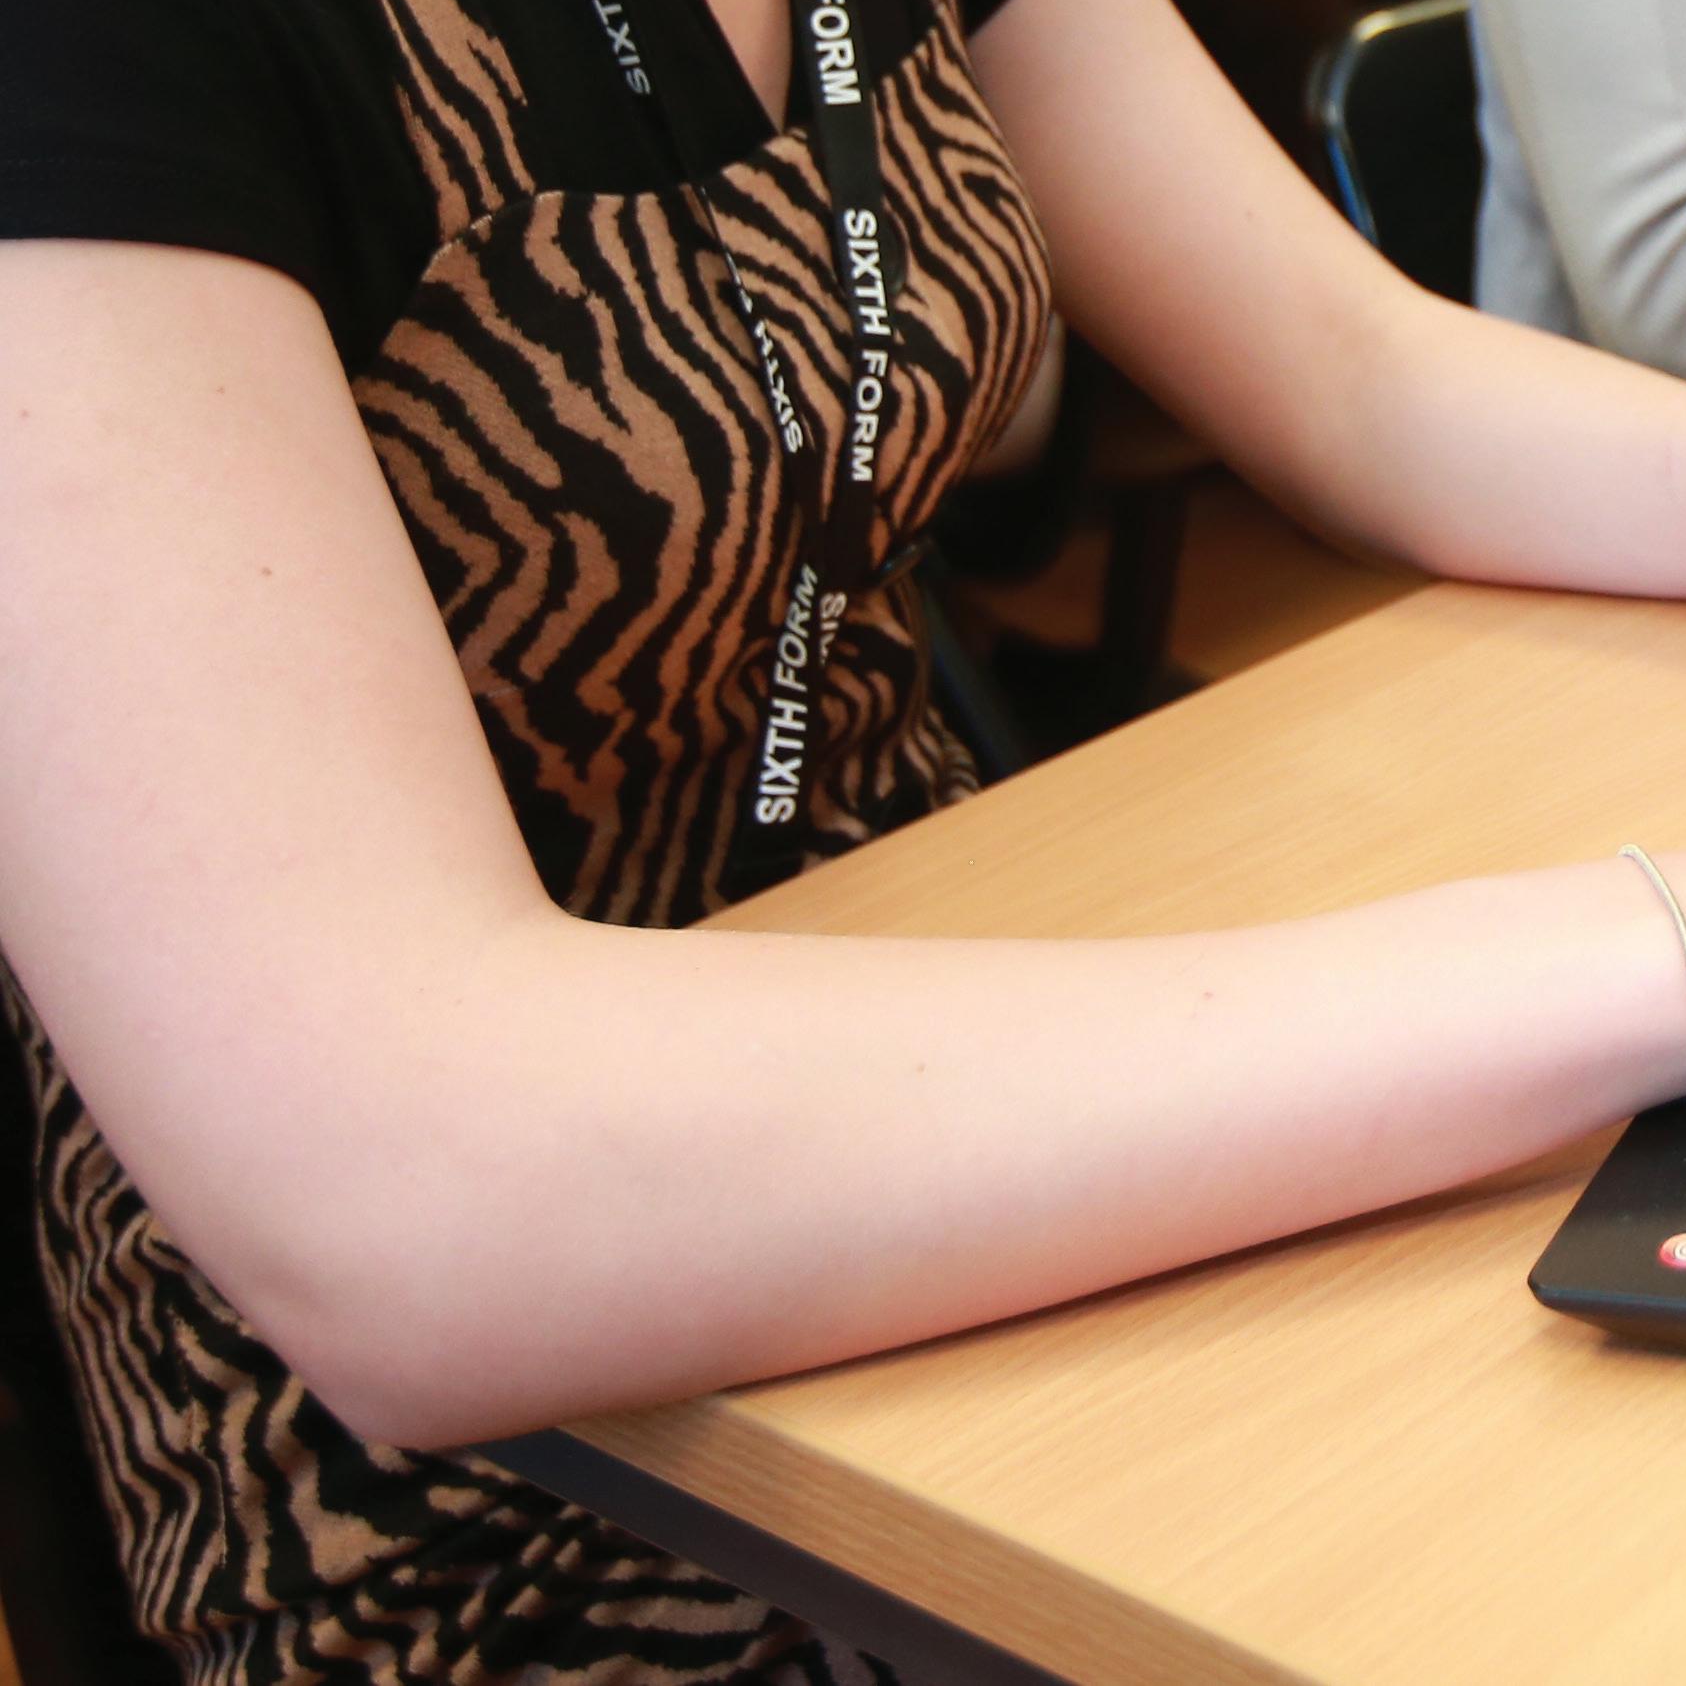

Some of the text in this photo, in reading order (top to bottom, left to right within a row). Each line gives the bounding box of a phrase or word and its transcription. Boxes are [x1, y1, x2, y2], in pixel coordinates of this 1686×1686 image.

[843, 210, 892, 482] SIXTH FORM
[754, 563, 818, 825] SIXTH FORM
